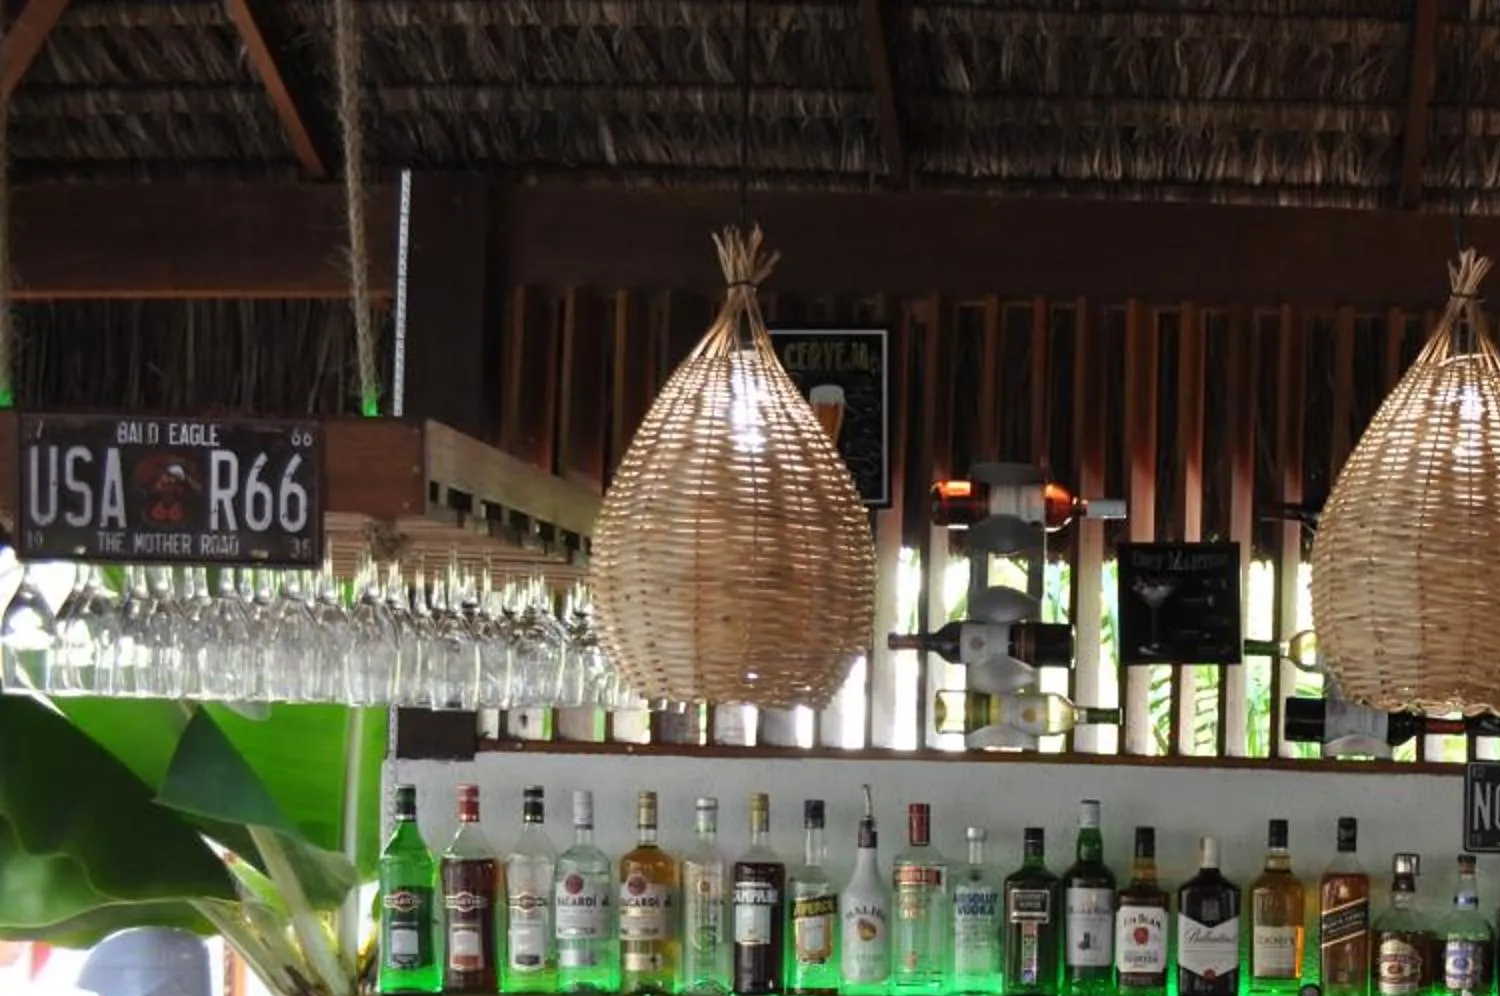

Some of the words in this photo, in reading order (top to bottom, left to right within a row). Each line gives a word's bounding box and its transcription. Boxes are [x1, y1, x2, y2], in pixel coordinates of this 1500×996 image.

[117, 421, 159, 445] BALD
[168, 422, 221, 447] EAGLE
[290, 429, 313, 449] 66
[29, 444, 127, 530] USA
[210, 449, 308, 533] R66
[97, 530, 127, 553] THE
[133, 532, 192, 556] MOTHER
[200, 534, 239, 557] ROAD
